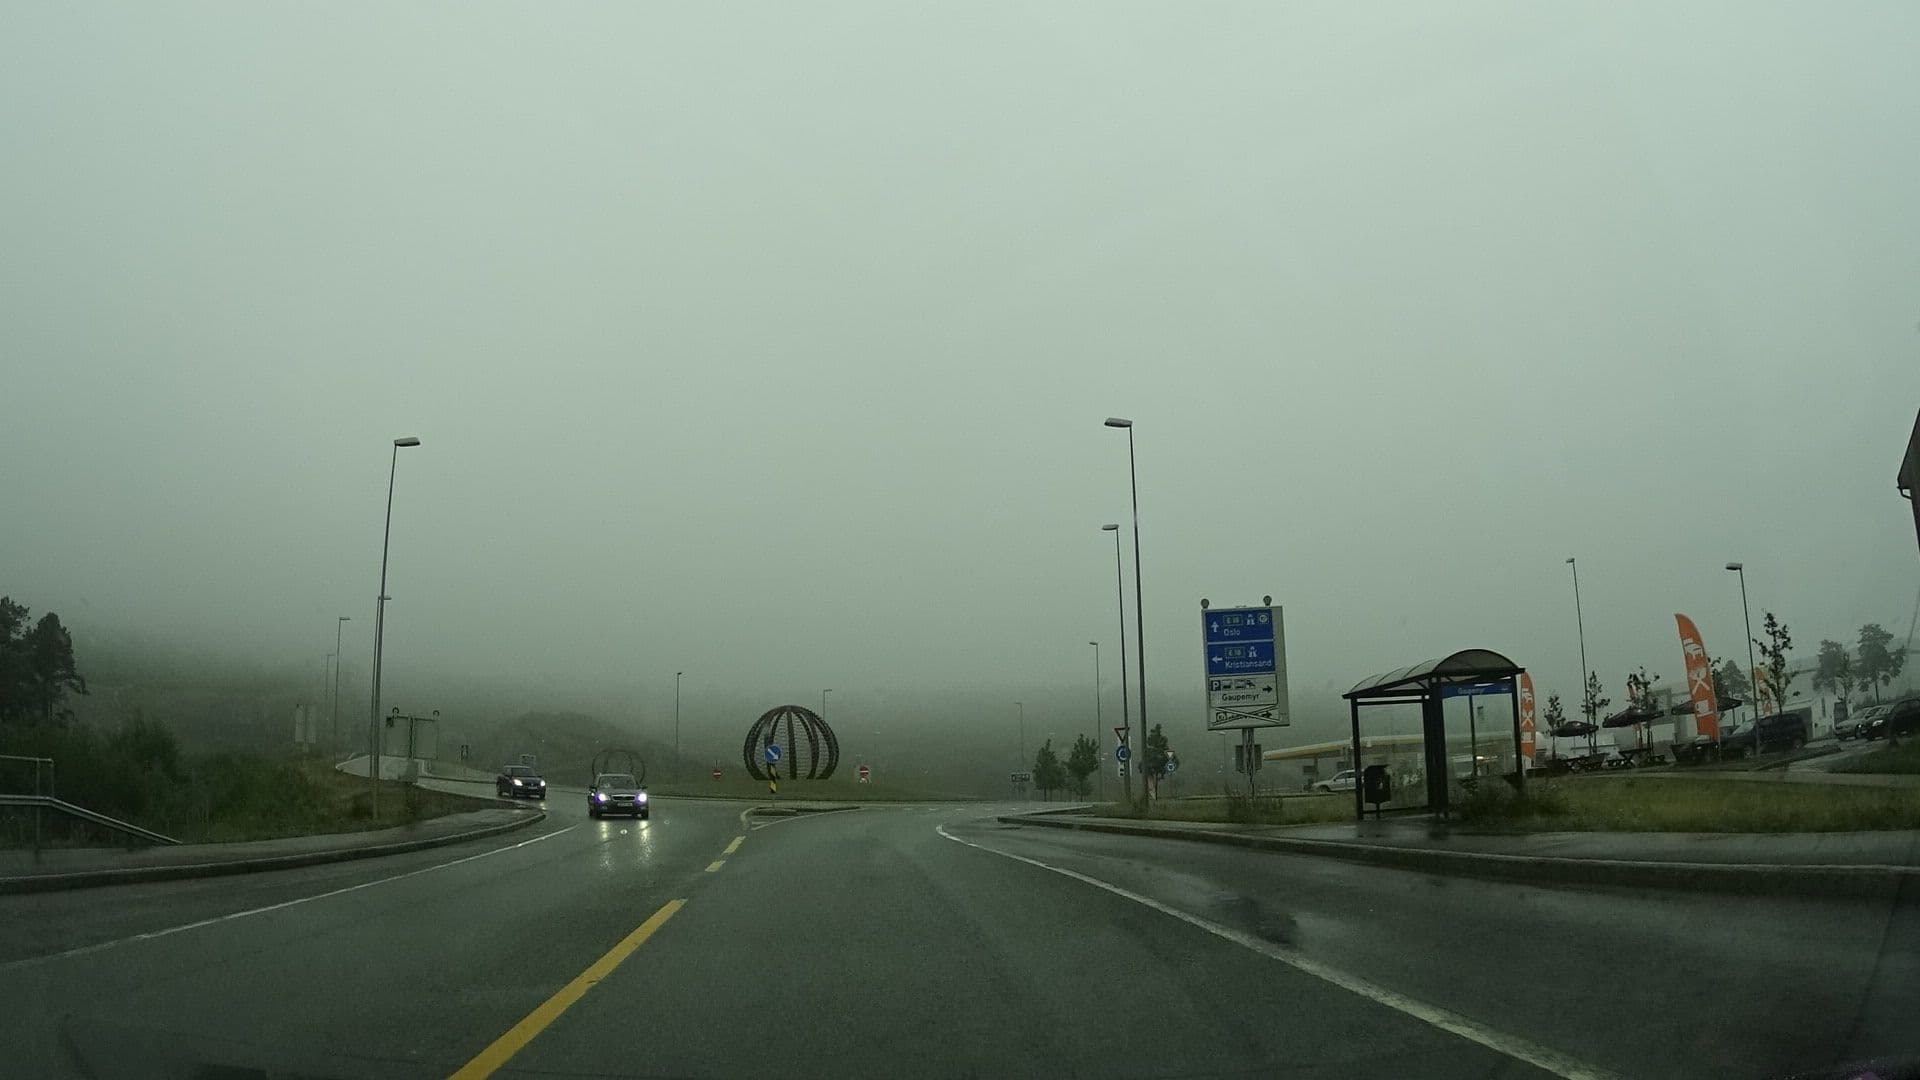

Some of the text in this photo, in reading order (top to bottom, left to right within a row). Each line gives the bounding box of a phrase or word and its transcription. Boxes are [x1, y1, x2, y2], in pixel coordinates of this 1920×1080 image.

[1223, 628, 1241, 636] Oslo
[1225, 659, 1272, 668] Kristiansand
[1222, 693, 1261, 702] Gaupemyr
